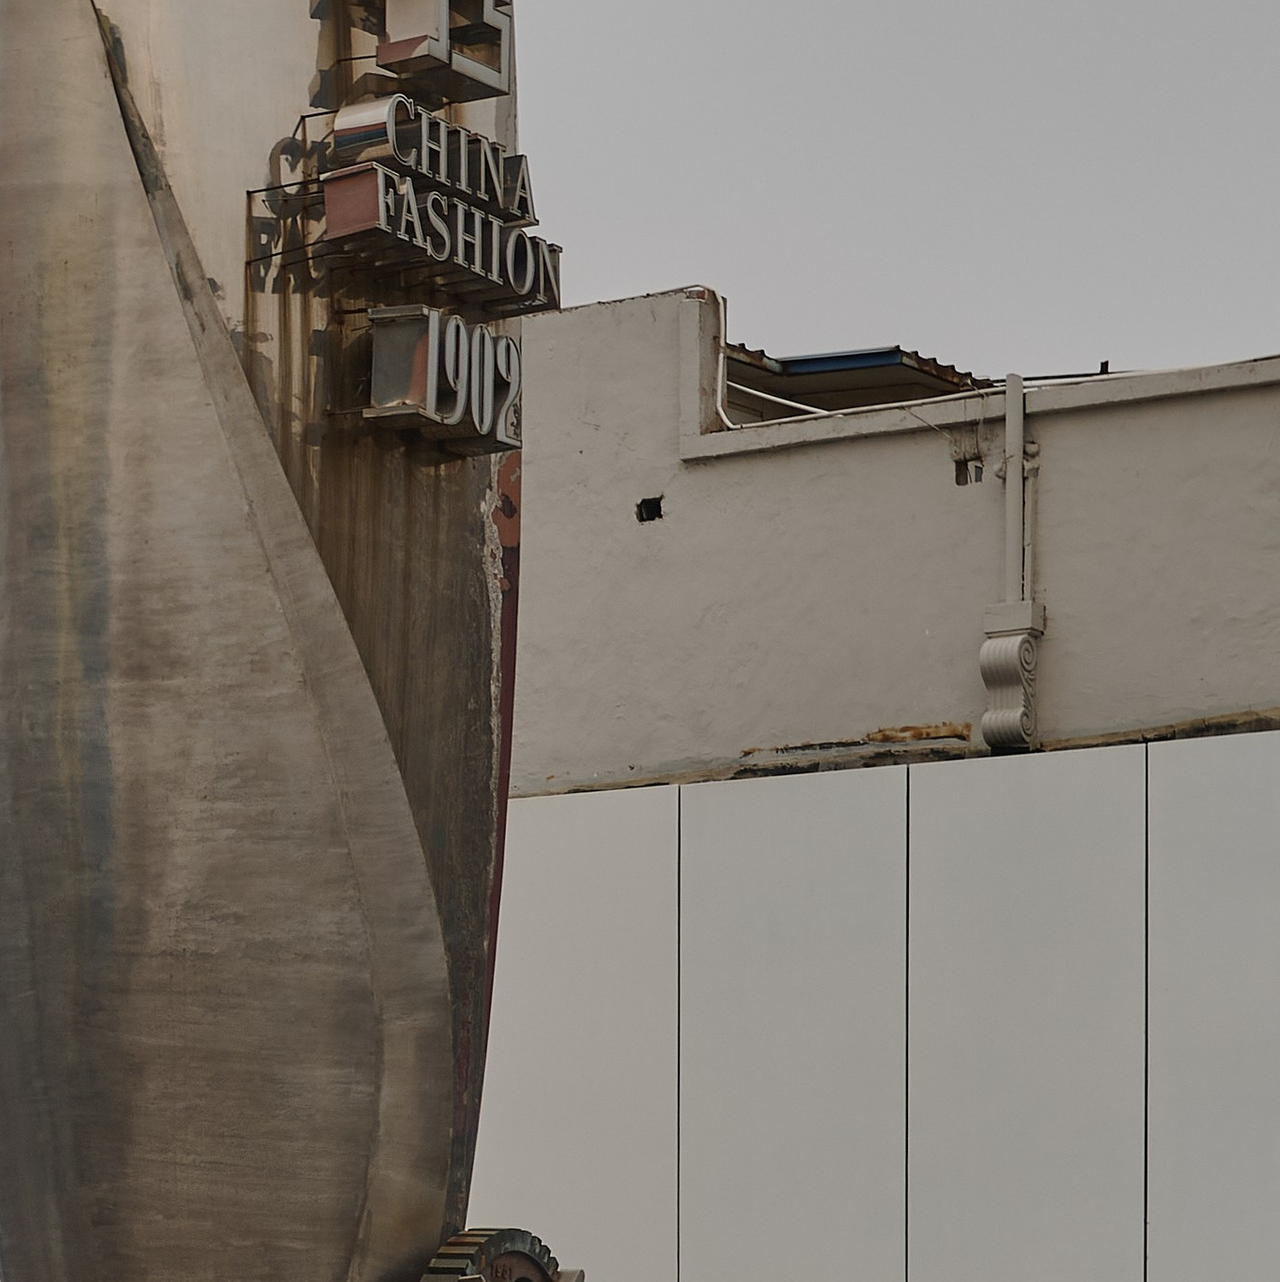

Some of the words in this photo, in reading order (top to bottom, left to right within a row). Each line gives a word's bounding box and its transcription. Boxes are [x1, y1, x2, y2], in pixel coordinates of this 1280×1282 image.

[386, 93, 538, 225] CHINA
[374, 162, 562, 309] FASHION
[422, 305, 522, 449] 1902
